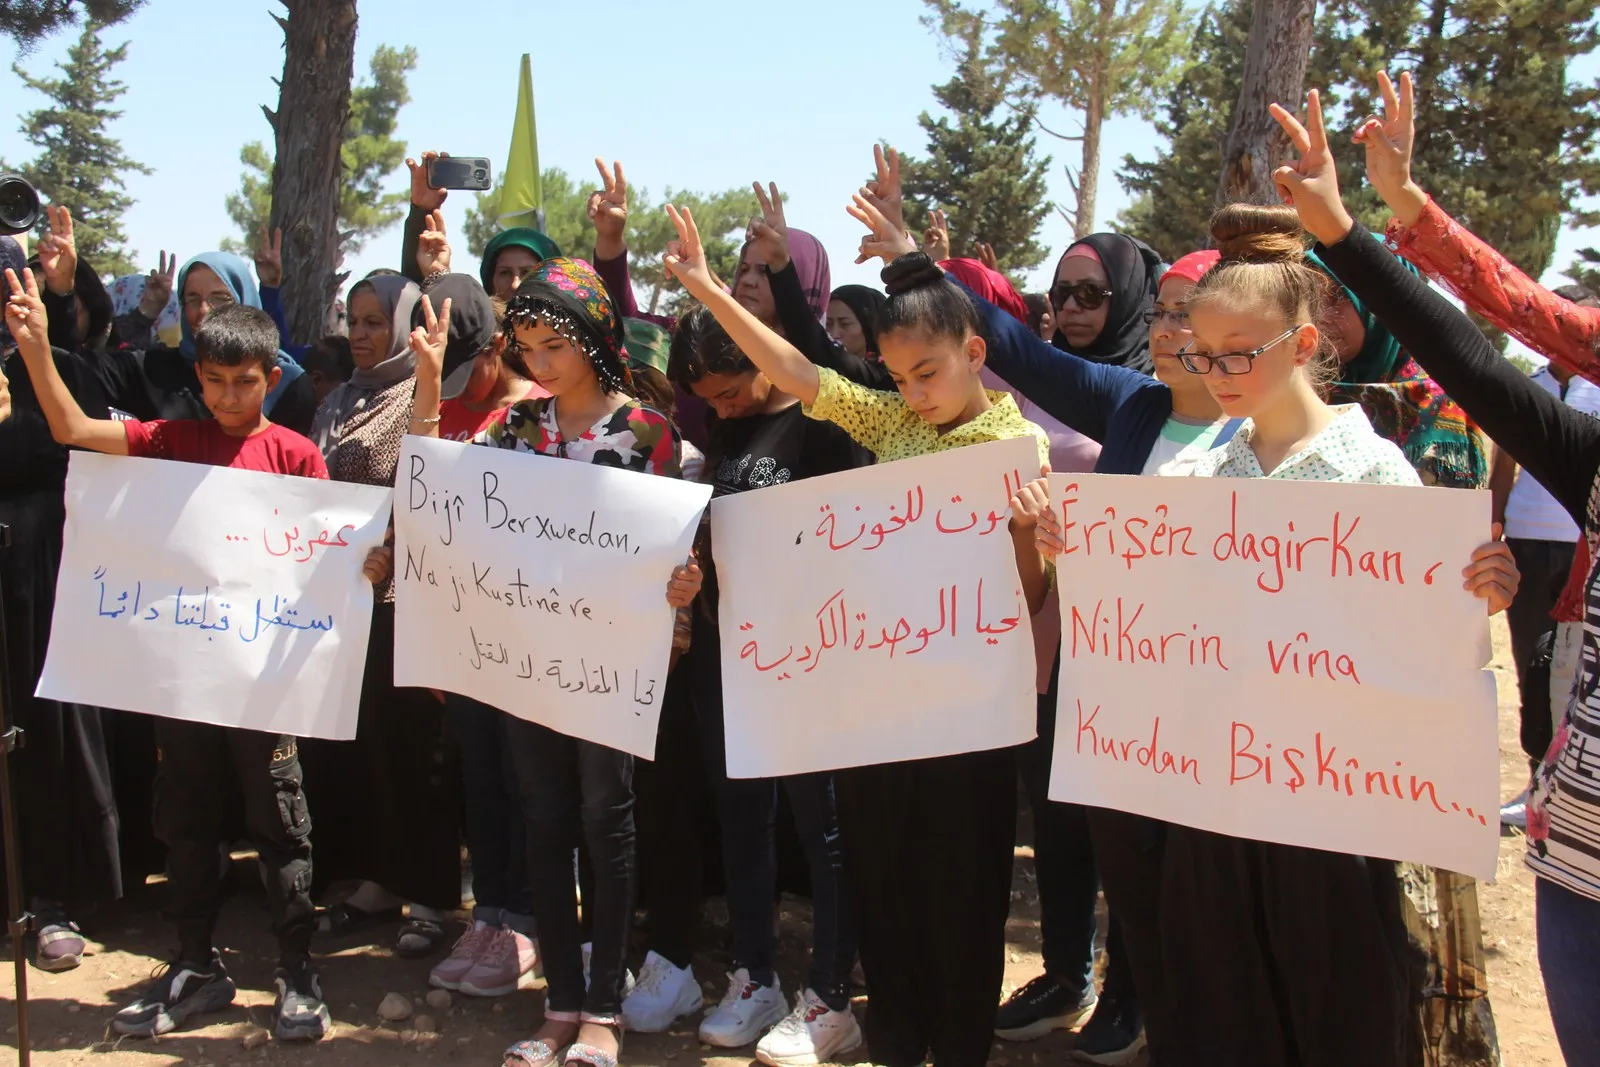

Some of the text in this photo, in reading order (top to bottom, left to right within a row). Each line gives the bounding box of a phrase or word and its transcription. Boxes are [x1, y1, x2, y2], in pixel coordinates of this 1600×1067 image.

[263, 508, 356, 563] عفرين
[408, 455, 641, 555] Bijî Berxwedan,
[815, 485, 924, 551] للخونة
[935, 468, 1022, 536] الوت
[404, 545, 439, 588] Na
[449, 566, 466, 613] ji
[515, 653, 533, 680] لا
[739, 588, 849, 681] الكردية
[1267, 633, 1361, 685] vîna
[1076, 698, 1202, 786] Kurdan
